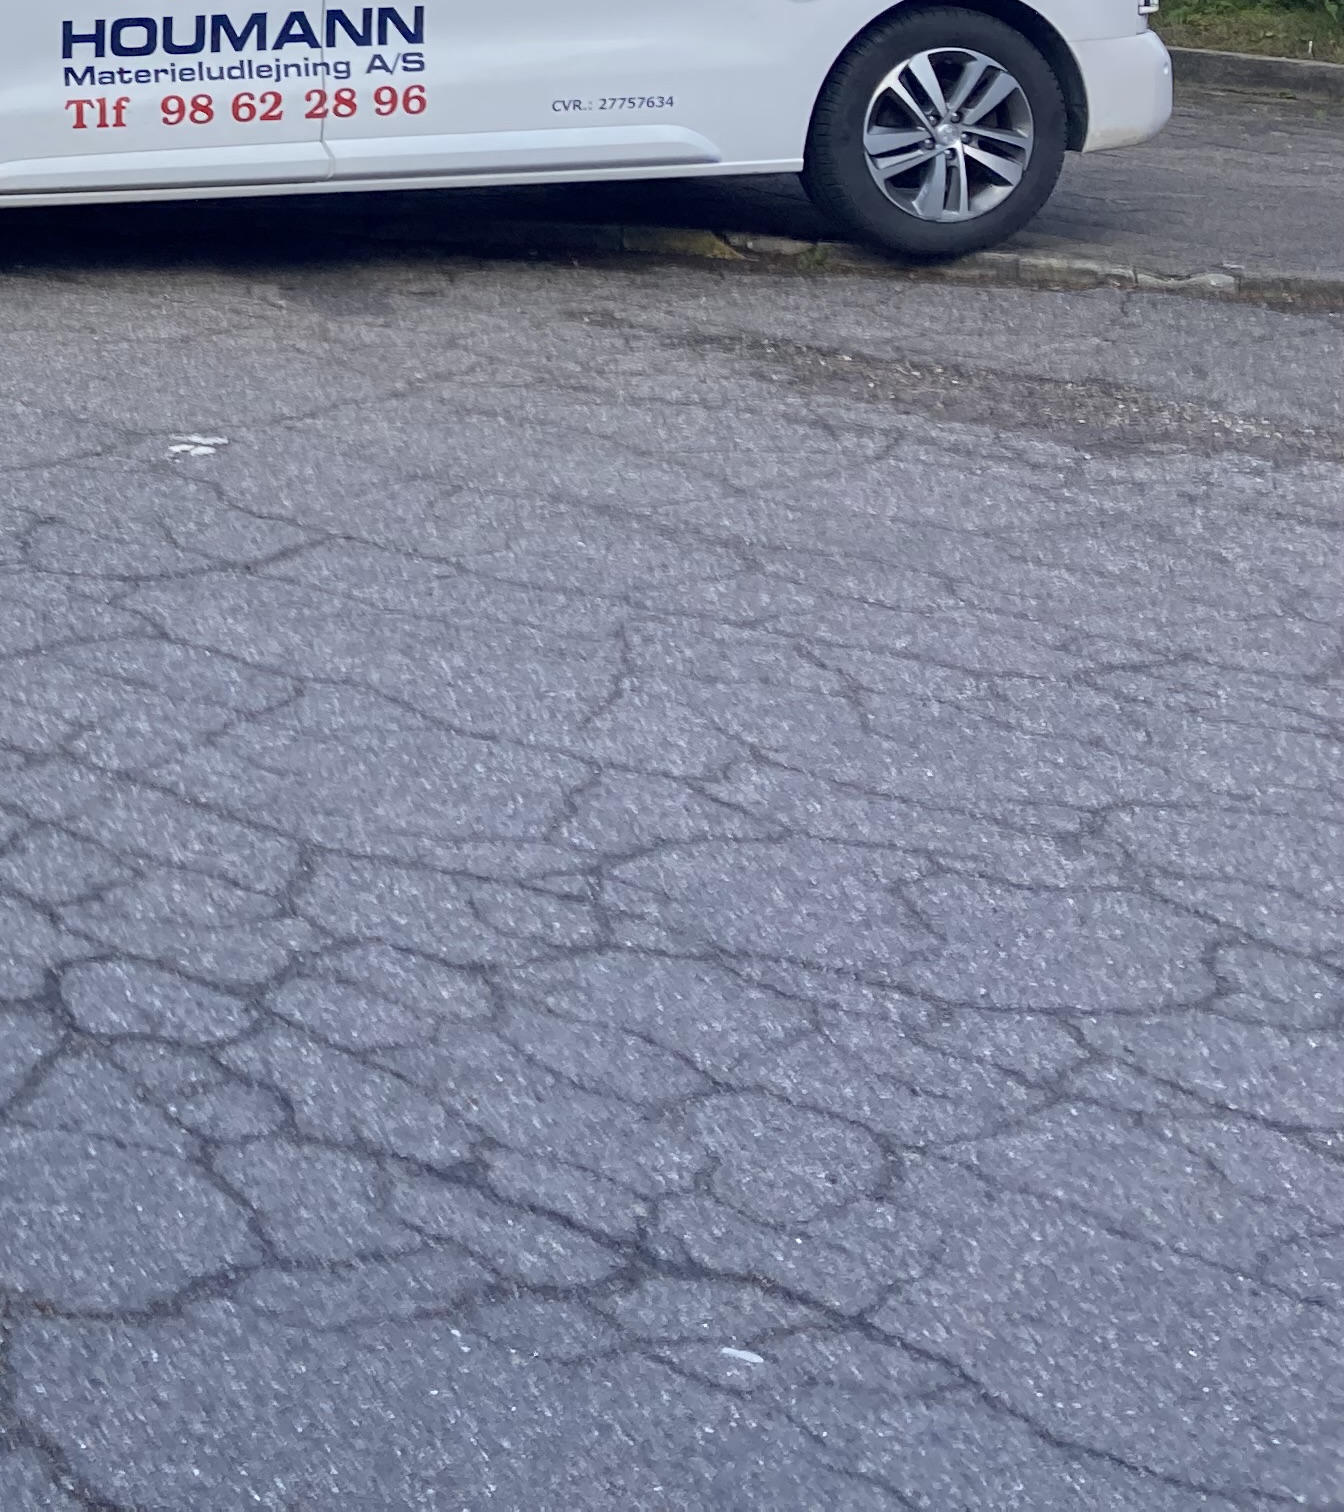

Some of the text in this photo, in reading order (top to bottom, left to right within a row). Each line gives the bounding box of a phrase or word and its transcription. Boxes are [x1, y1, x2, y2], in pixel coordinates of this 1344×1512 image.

[62, 5, 425, 59] HOUMANN
[64, 51, 426, 86] Materieludlejning A/S
[65, 84, 427, 129] Tlf 98 62 28 96
[598, 96, 675, 110] 27757634
